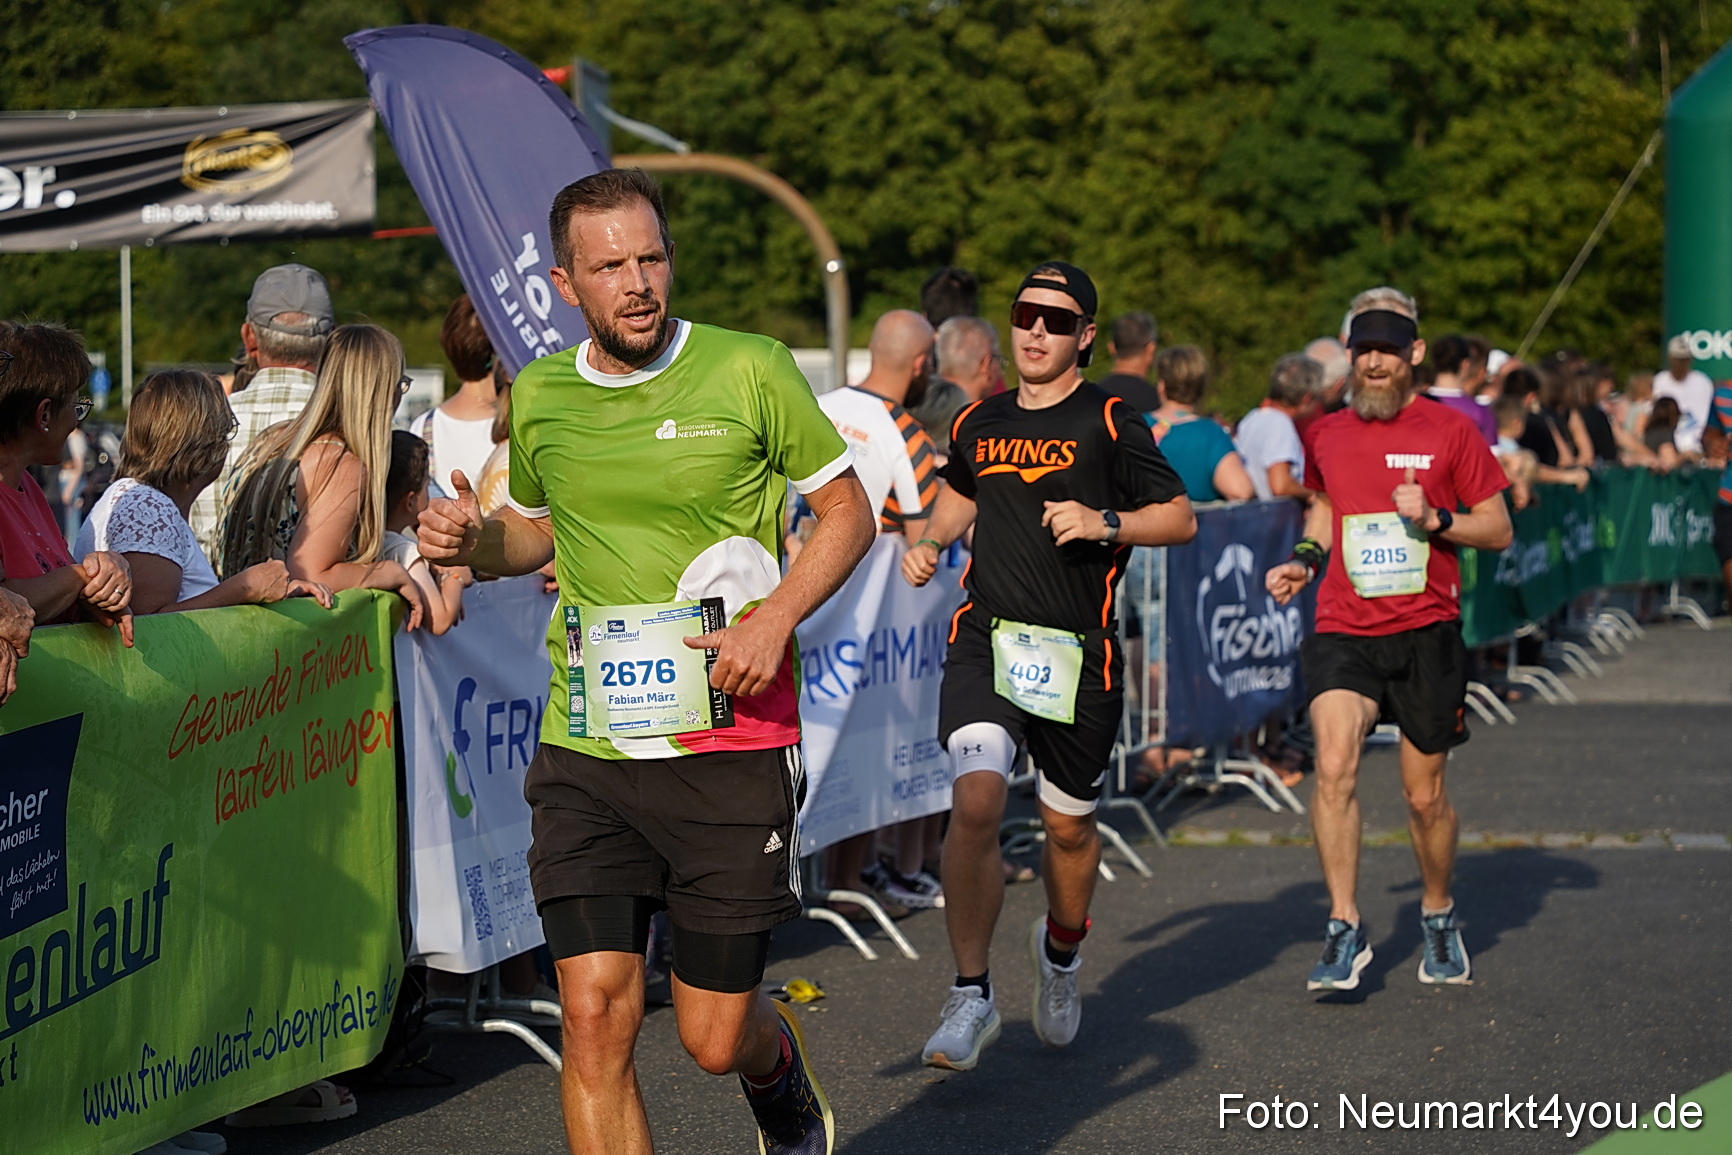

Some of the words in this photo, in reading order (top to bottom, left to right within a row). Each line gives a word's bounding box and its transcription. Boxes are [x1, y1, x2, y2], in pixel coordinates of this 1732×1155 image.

[677, 428, 728, 438] NEUMARKT
[988, 437, 1078, 467] WINGS
[1385, 454, 1431, 469] THULE
[1361, 547, 1407, 565] 2815
[603, 630, 640, 641] Firmenlauf
[600, 658, 677, 687] 2676
[1010, 661, 1051, 684] 403
[168, 648, 292, 760] Gesunde
[297, 633, 374, 705] Firmen
[608, 693, 644, 705] Fabian
[646, 691, 676, 703] März
[214, 735, 296, 826] laufen
[302, 706, 394, 788] länger
[5, 842, 174, 1028] enlauf
